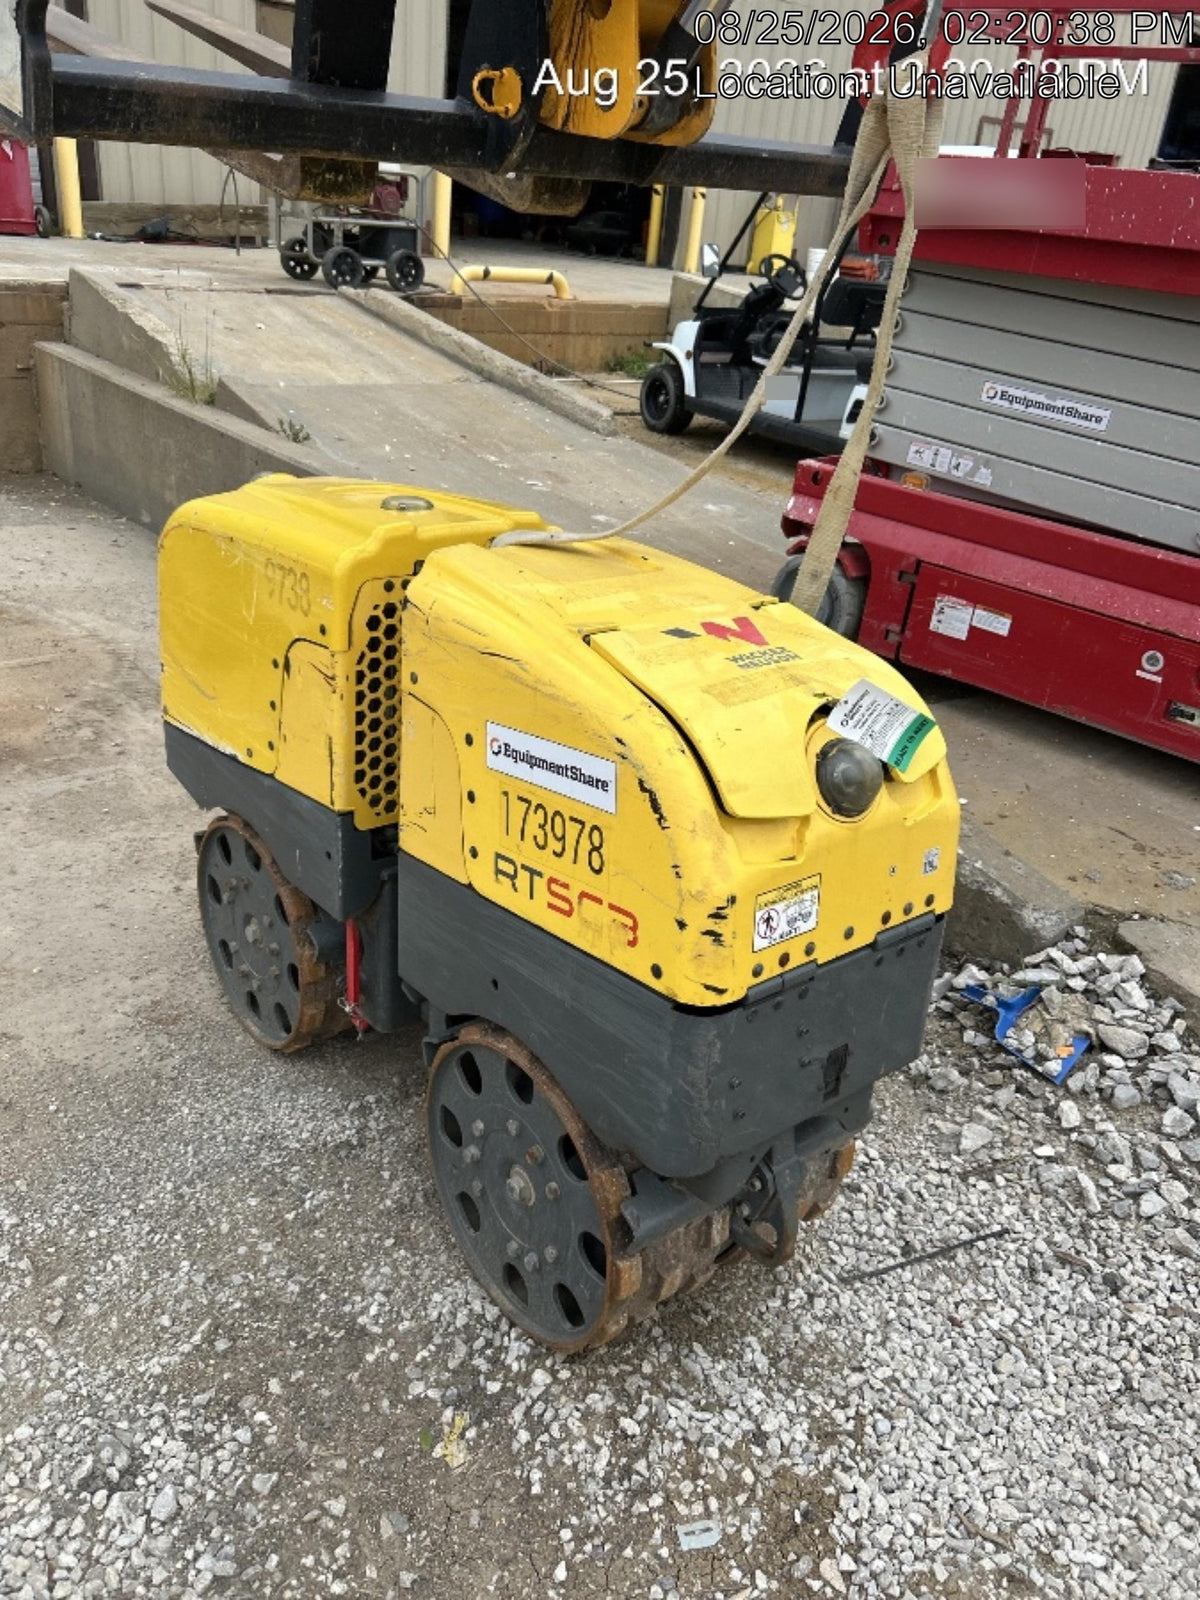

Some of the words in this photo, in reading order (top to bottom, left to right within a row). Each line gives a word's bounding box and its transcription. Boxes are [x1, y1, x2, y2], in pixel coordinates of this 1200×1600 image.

[1000, 390, 1103, 424] EquipmentShare
[502, 741, 610, 793] EquipmentShare
[502, 790, 605, 876] 173978
